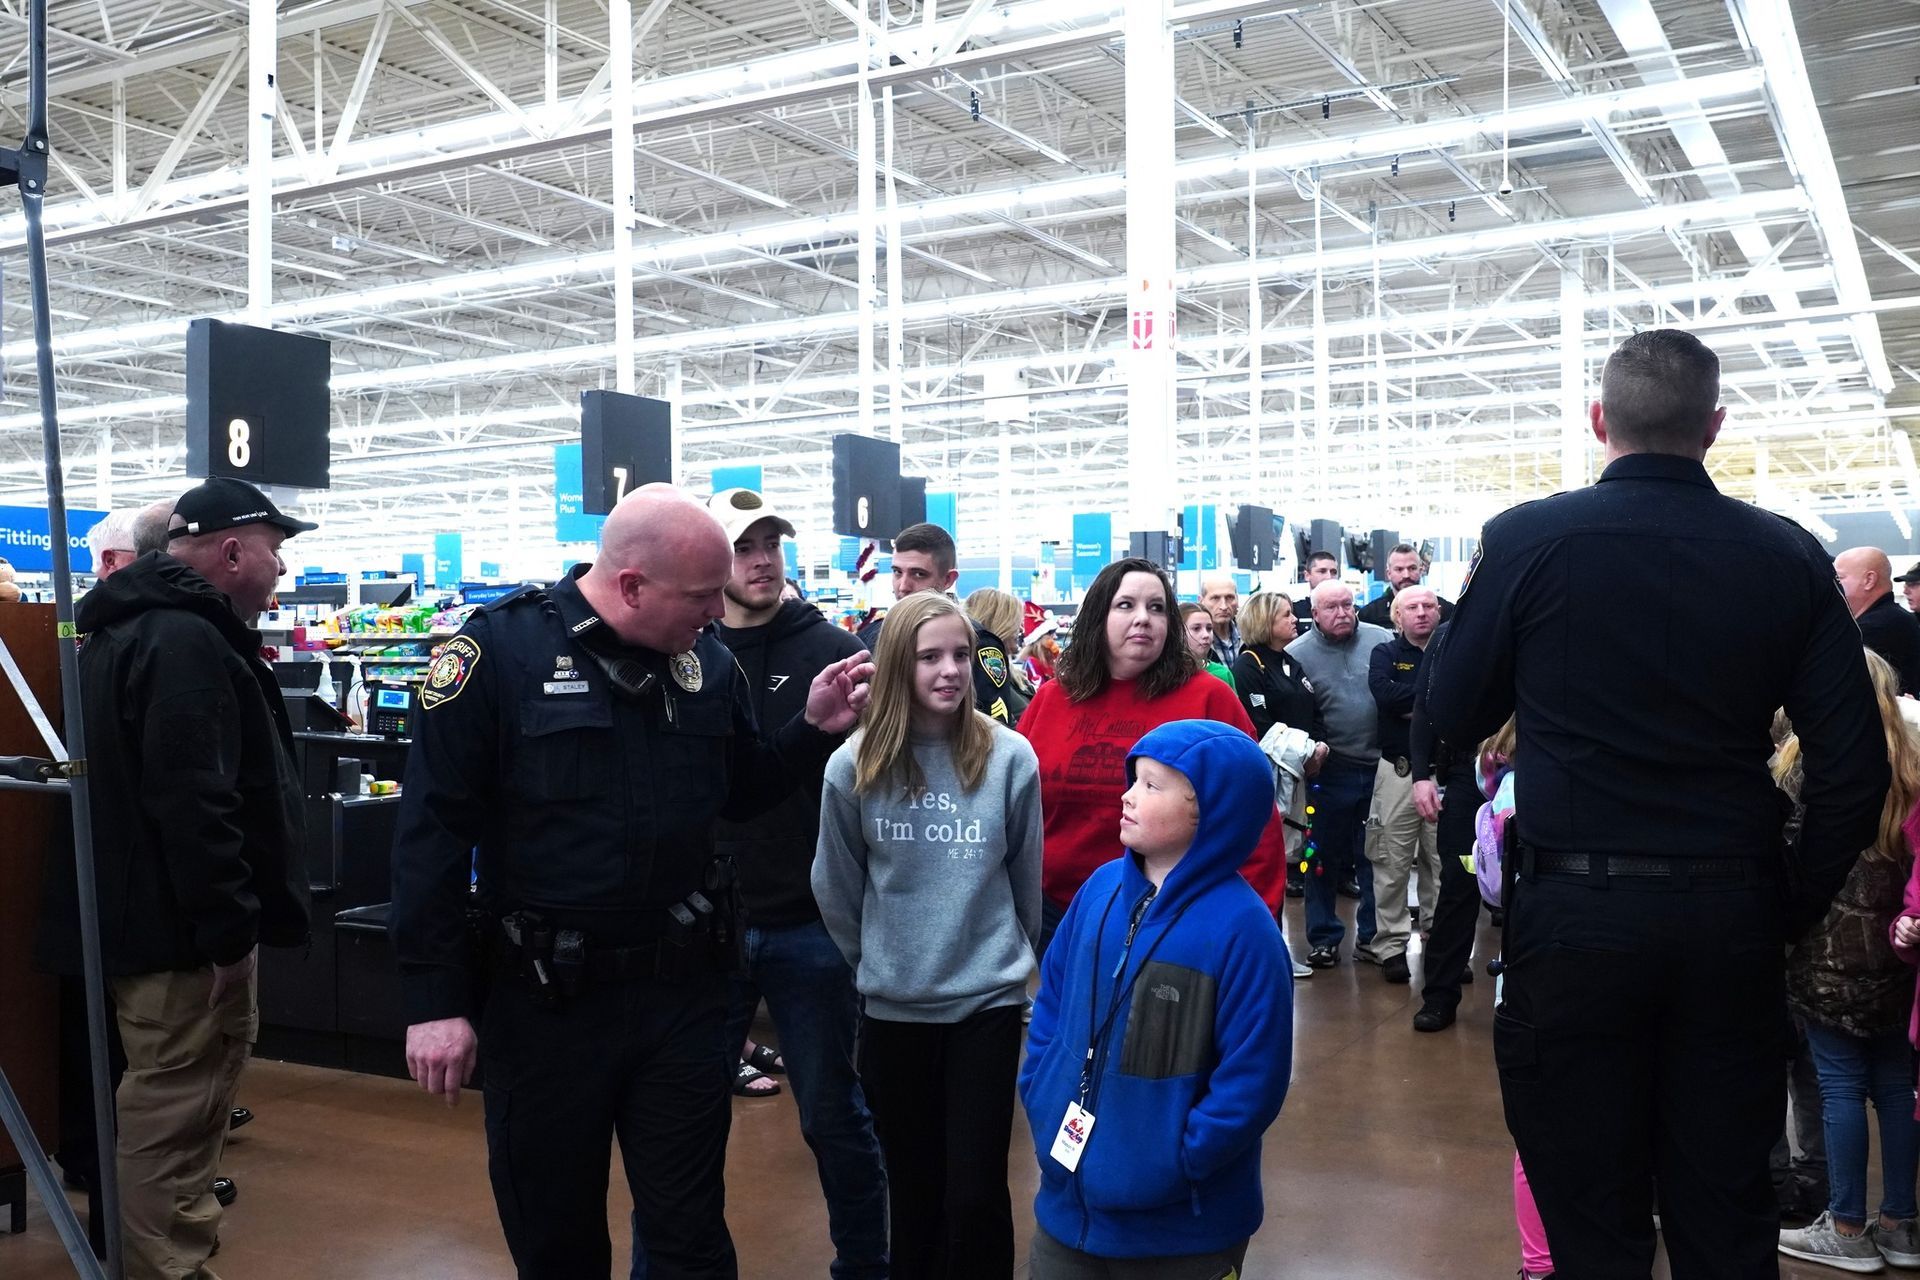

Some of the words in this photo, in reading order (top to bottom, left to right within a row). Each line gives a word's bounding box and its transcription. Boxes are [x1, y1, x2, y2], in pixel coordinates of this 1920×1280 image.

[228, 418, 250, 467] 8
[560, 492, 583, 502] Wome
[613, 467, 627, 504] 7
[560, 504, 576, 514] Plus
[857, 496, 869, 529] 6
[0, 527, 51, 551] Fitting
[1252, 544, 1259, 565] 3
[468, 592, 488, 600] Everyday
[445, 640, 476, 658] SHERIFF
[903, 786, 957, 813] Yes,
[875, 818, 915, 842] I'm
[924, 818, 987, 843] cold.
